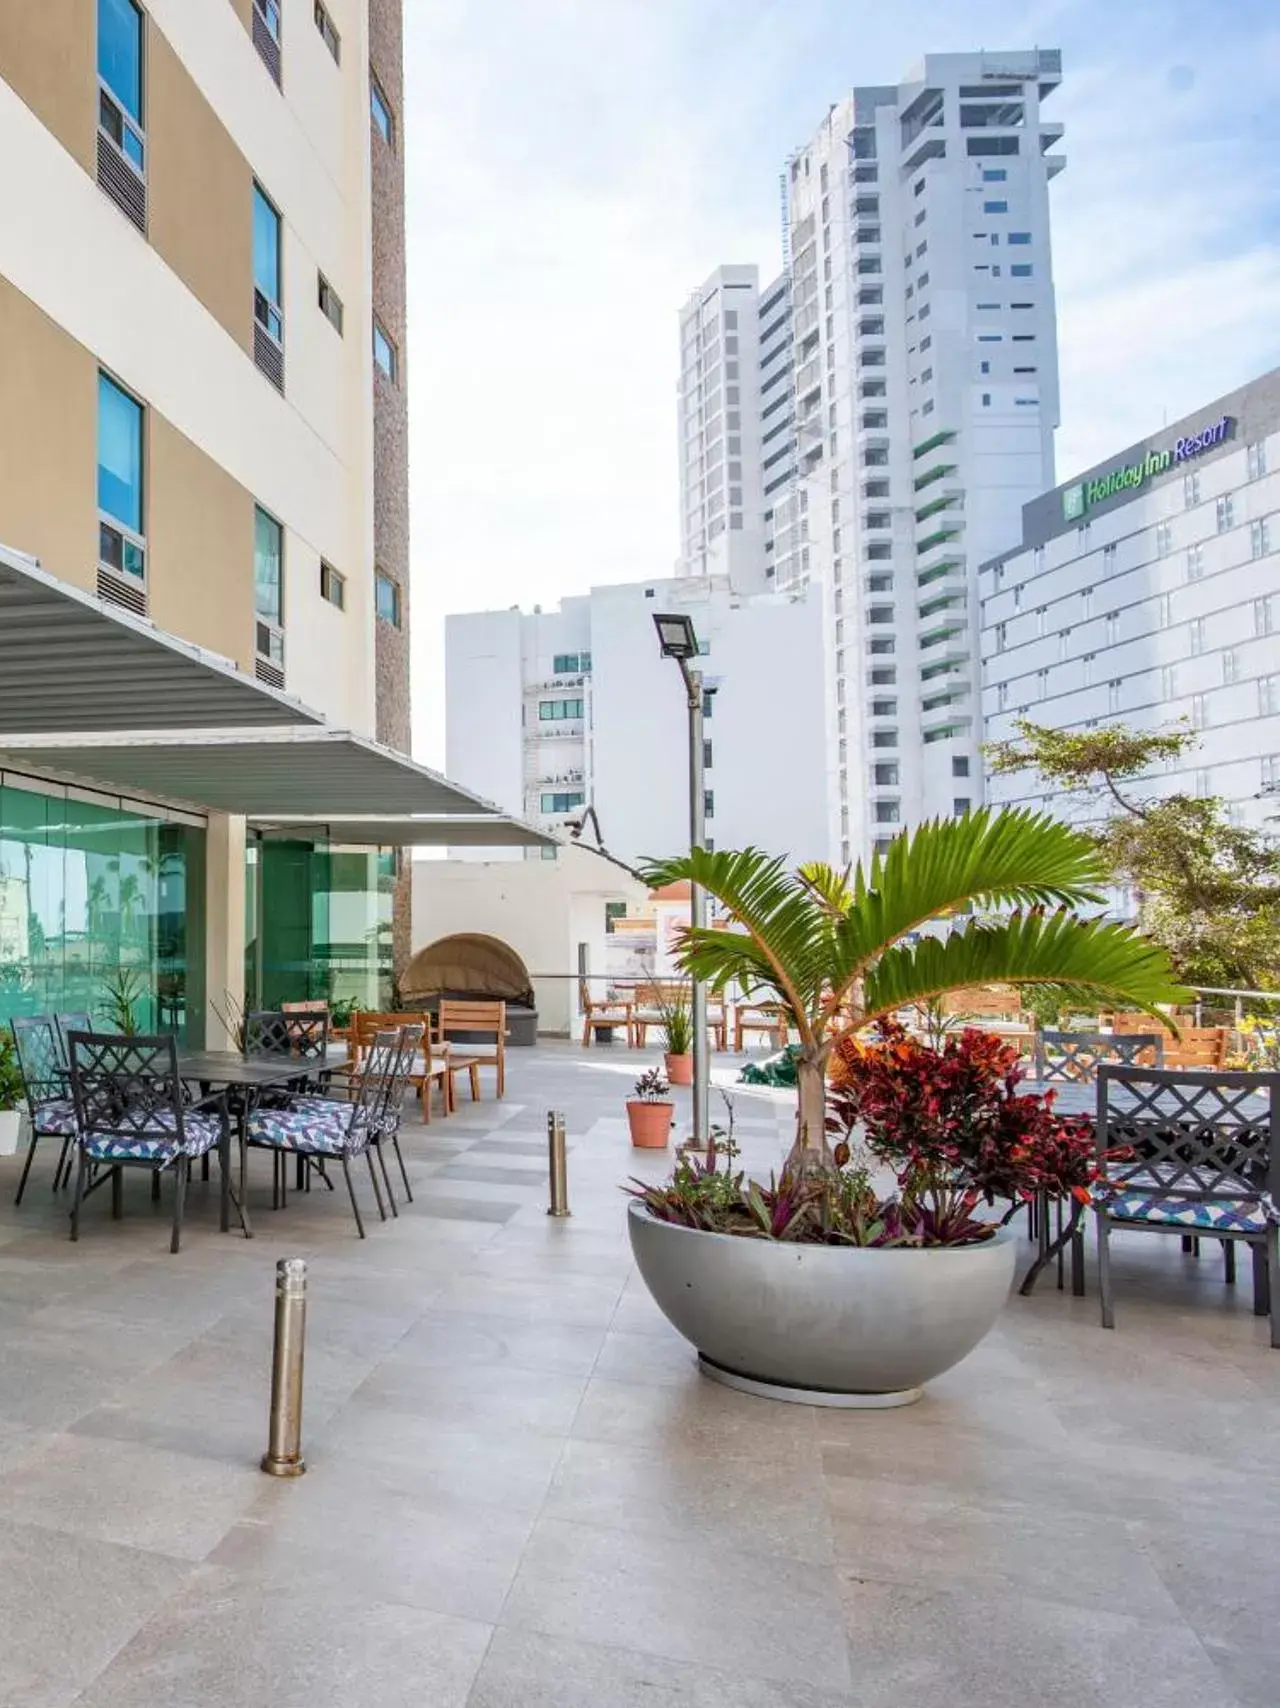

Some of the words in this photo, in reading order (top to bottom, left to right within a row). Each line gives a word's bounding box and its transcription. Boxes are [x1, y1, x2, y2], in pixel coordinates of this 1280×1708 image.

[1087, 463, 1143, 503] Holiday
[1144, 451, 1169, 476] Inn
[1174, 416, 1229, 461] Resort
